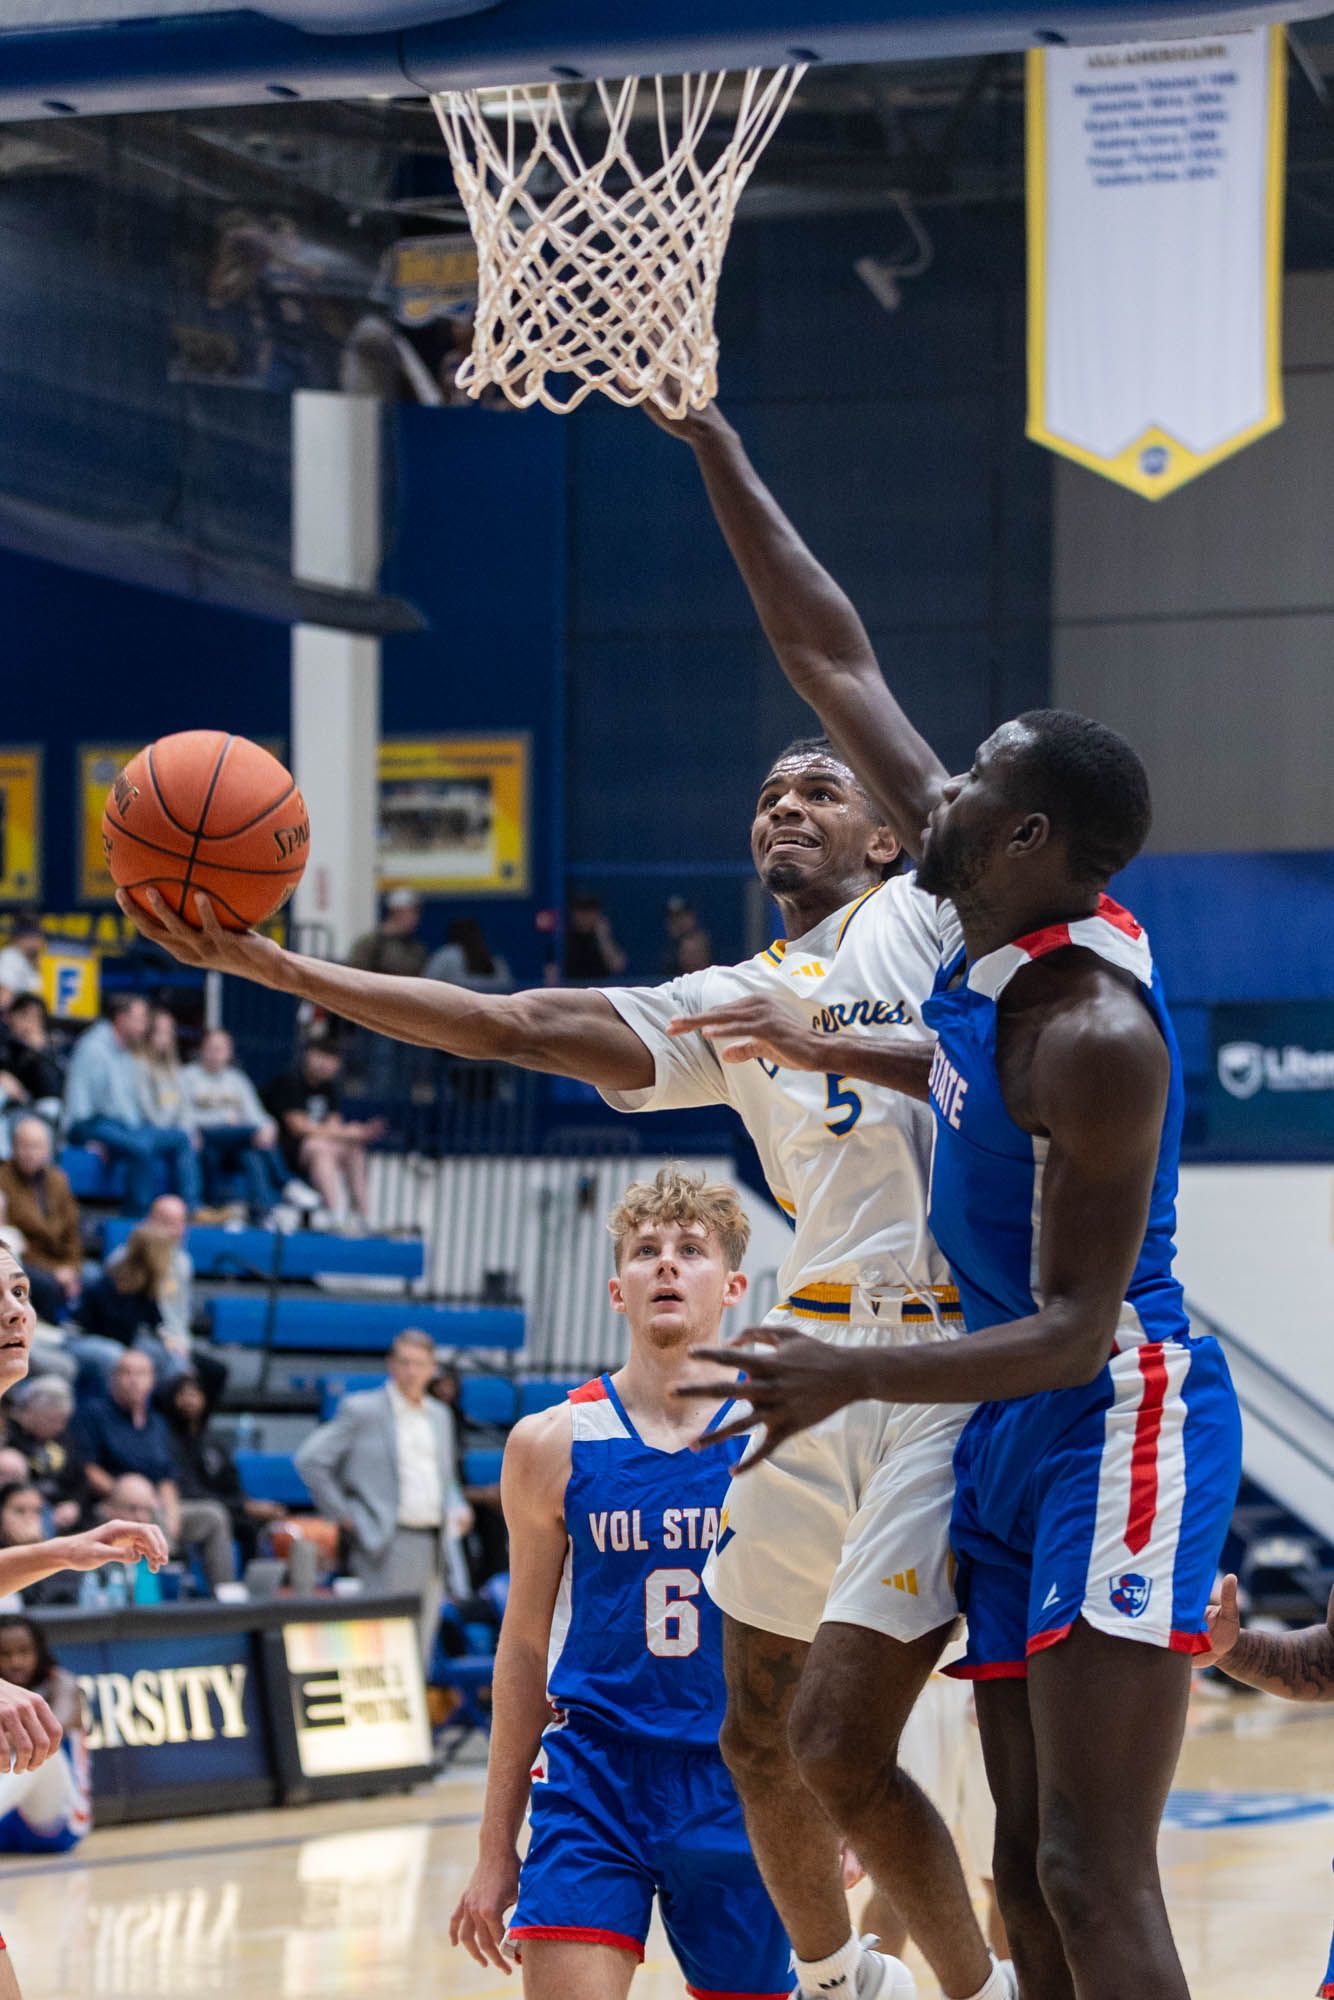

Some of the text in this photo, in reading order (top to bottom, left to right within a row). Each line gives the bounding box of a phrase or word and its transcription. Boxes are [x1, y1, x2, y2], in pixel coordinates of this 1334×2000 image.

[823, 1070, 864, 1139] 5
[588, 1509, 650, 1553] VOL
[662, 1507, 724, 1550] STA
[645, 1568, 701, 1658] 6
